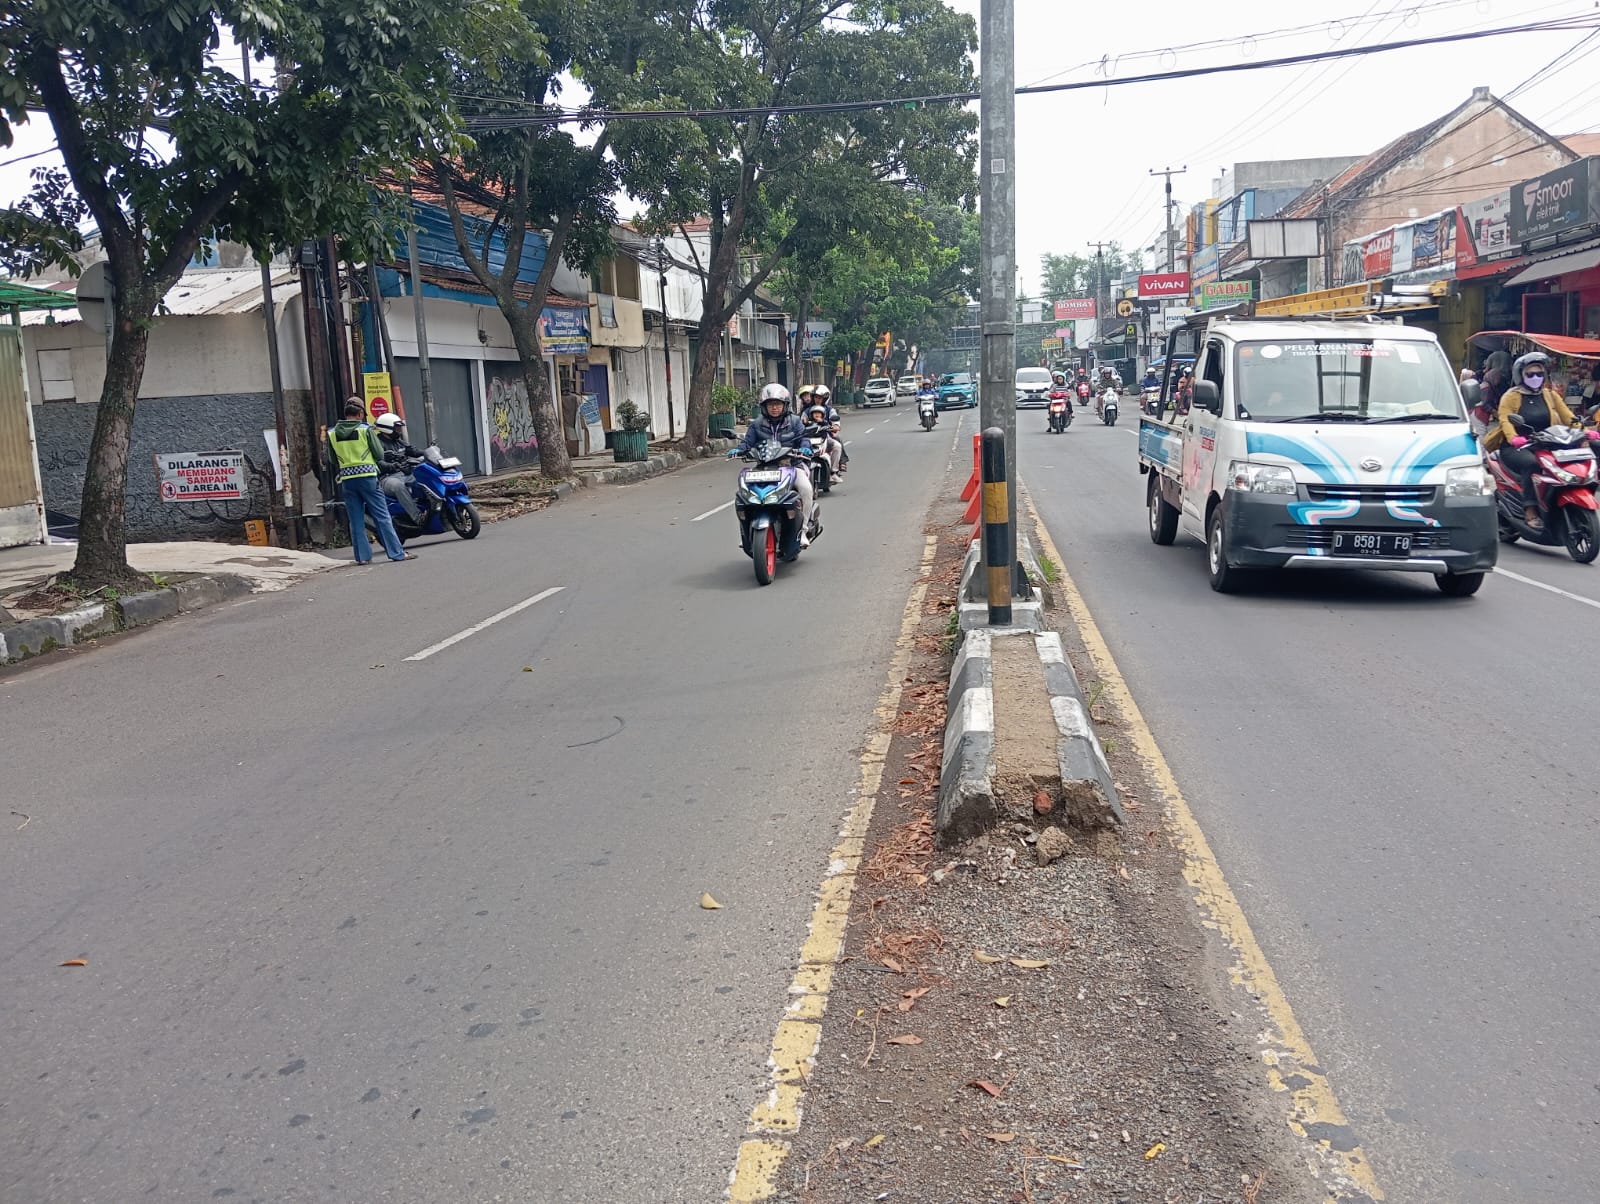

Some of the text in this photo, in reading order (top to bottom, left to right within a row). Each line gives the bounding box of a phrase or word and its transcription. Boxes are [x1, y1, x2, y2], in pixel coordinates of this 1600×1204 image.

[1284, 343, 1352, 351] PELAYANAN
[168, 459, 229, 470] DILARANG
[177, 468, 236, 477] MEMBUANG
[187, 476, 229, 485] SAMPAH
[193, 484, 219, 492] AREA
[223, 483, 238, 491] INI
[1335, 534, 1343, 548] D
[1353, 535, 1381, 549] 8581
